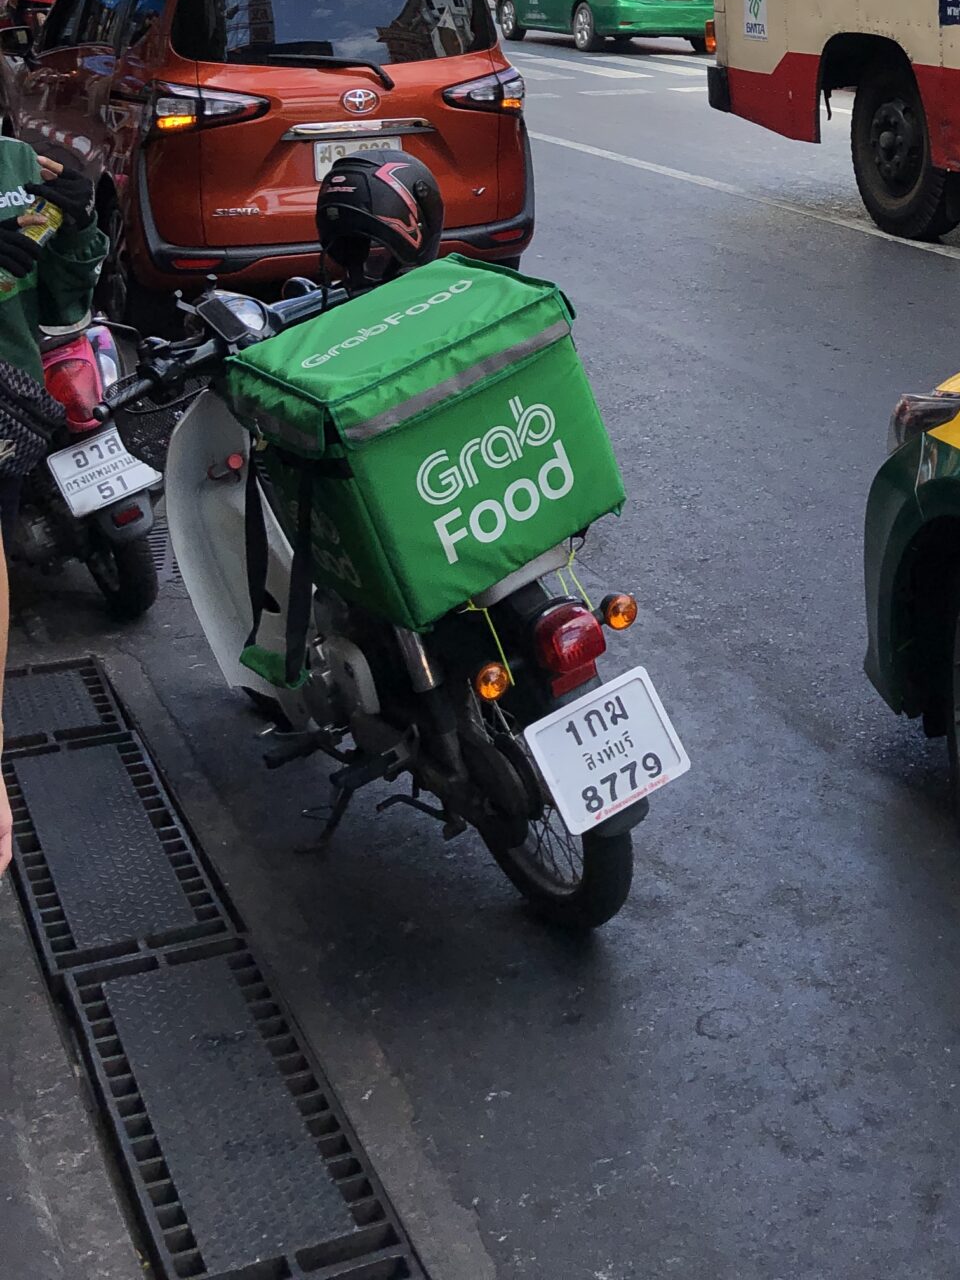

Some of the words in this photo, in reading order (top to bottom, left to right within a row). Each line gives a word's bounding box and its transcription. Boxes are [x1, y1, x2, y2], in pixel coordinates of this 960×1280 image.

[212, 207, 260, 217] SIENTA
[302, 277, 474, 370] GrabFood
[416, 395, 556, 506] Grab
[433, 439, 576, 565] Food
[581, 752, 663, 814] 8779
[582, 730, 635, 771] สิงห์บุรี
